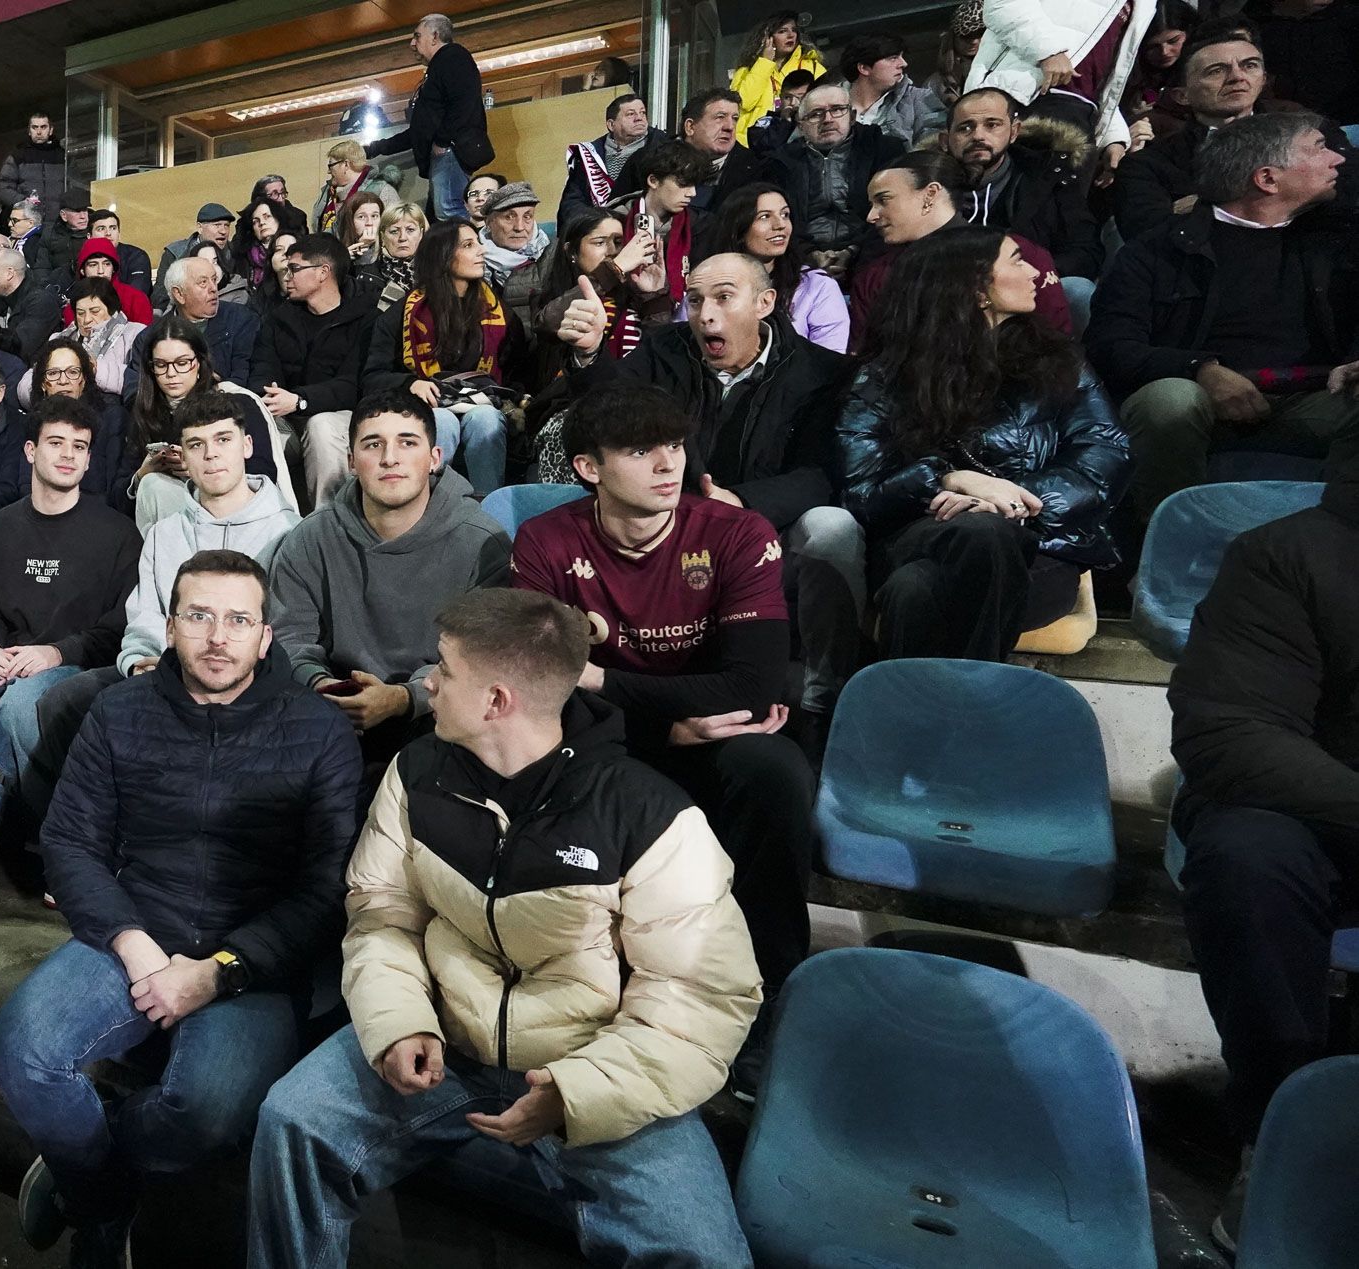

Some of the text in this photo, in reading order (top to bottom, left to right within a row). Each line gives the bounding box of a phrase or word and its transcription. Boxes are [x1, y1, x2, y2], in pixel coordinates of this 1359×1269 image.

[26, 558, 61, 568] NEW YORK
[25, 566, 60, 576] ATH. DEPT.
[729, 611, 758, 622] VOLTAR
[618, 615, 713, 641] Deputació
[555, 849, 586, 862] NORTH
[569, 845, 586, 855] THE
[562, 856, 584, 868] FACE
